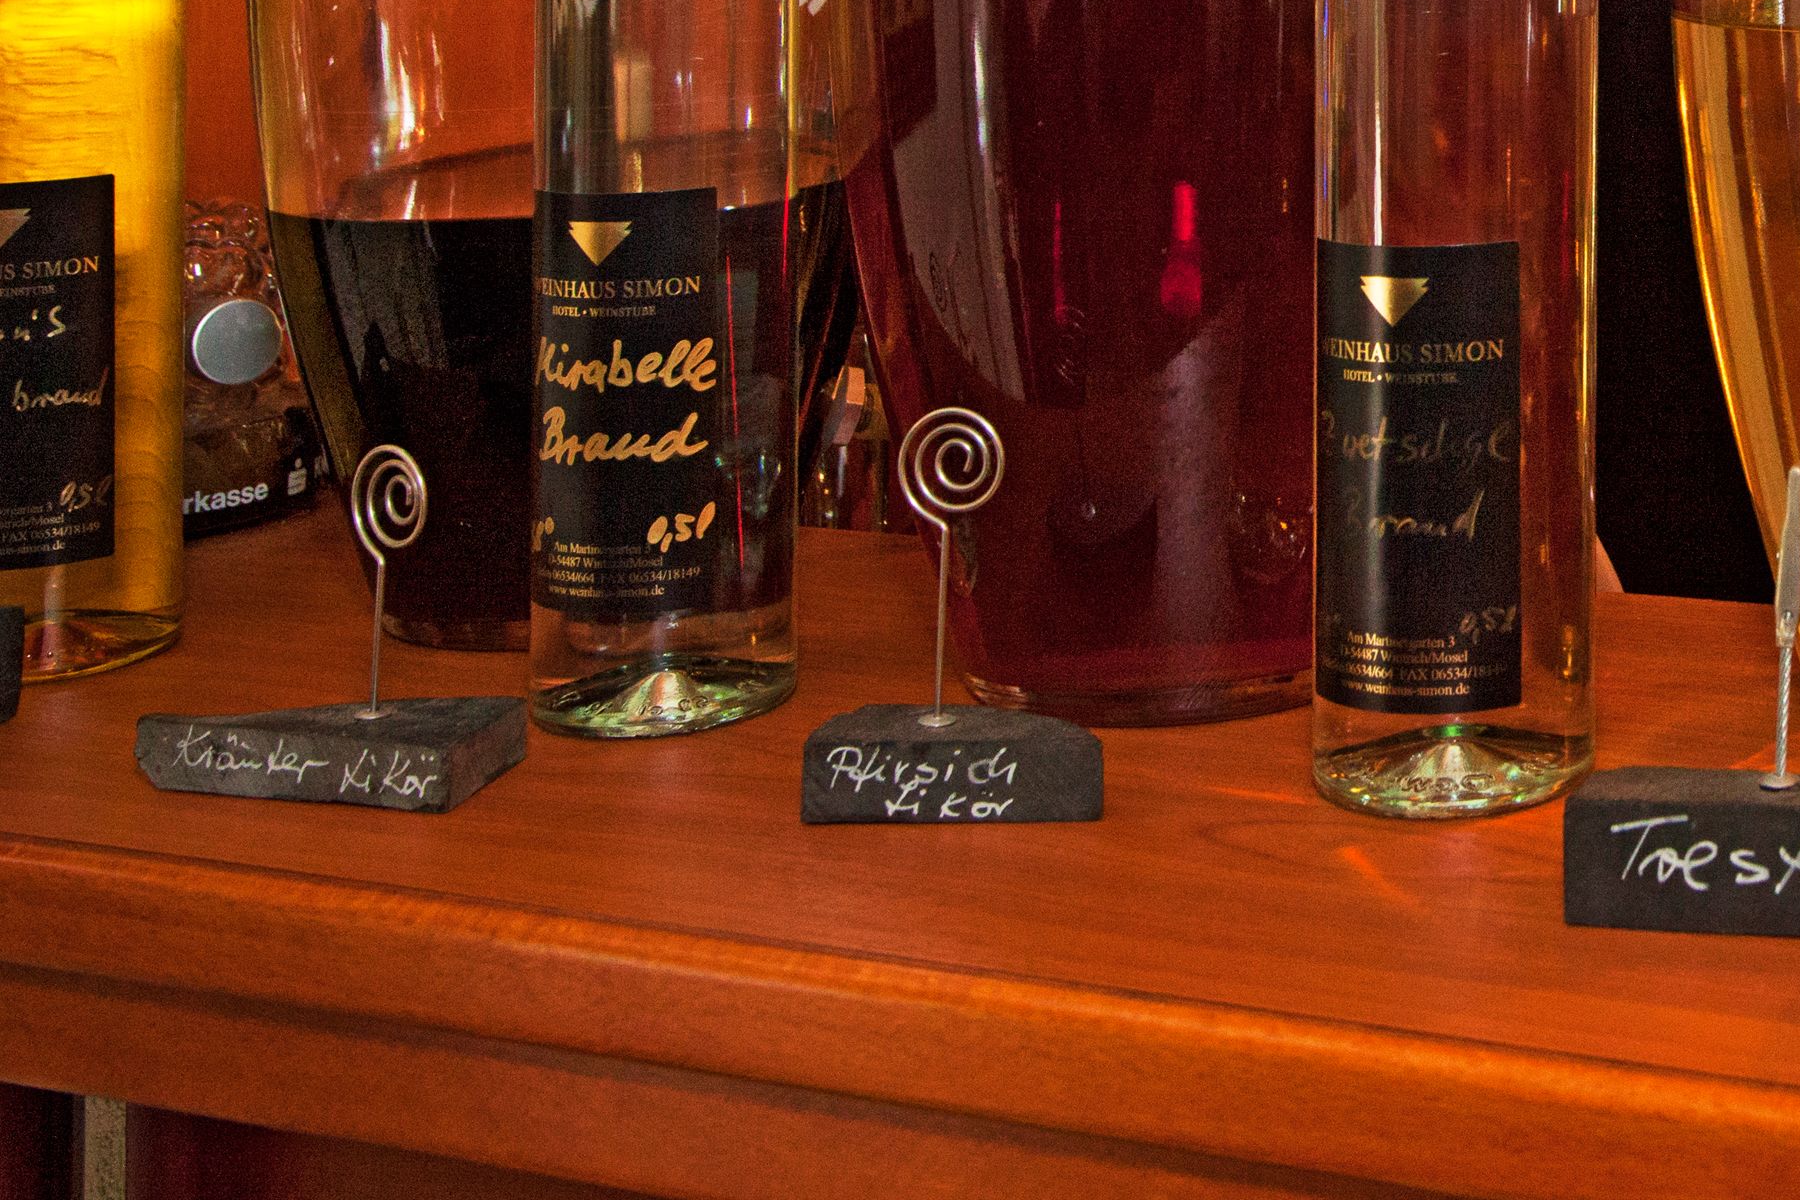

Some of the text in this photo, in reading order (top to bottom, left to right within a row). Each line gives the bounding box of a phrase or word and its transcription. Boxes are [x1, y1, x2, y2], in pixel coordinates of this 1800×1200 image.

[22, 256, 99, 279] SIMON
[623, 276, 701, 299] SIMON
[552, 305, 581, 317] HOTEL
[1419, 339, 1504, 364] SIMON
[1343, 369, 1375, 383] HOTEL
[182, 482, 269, 514] rkasse
